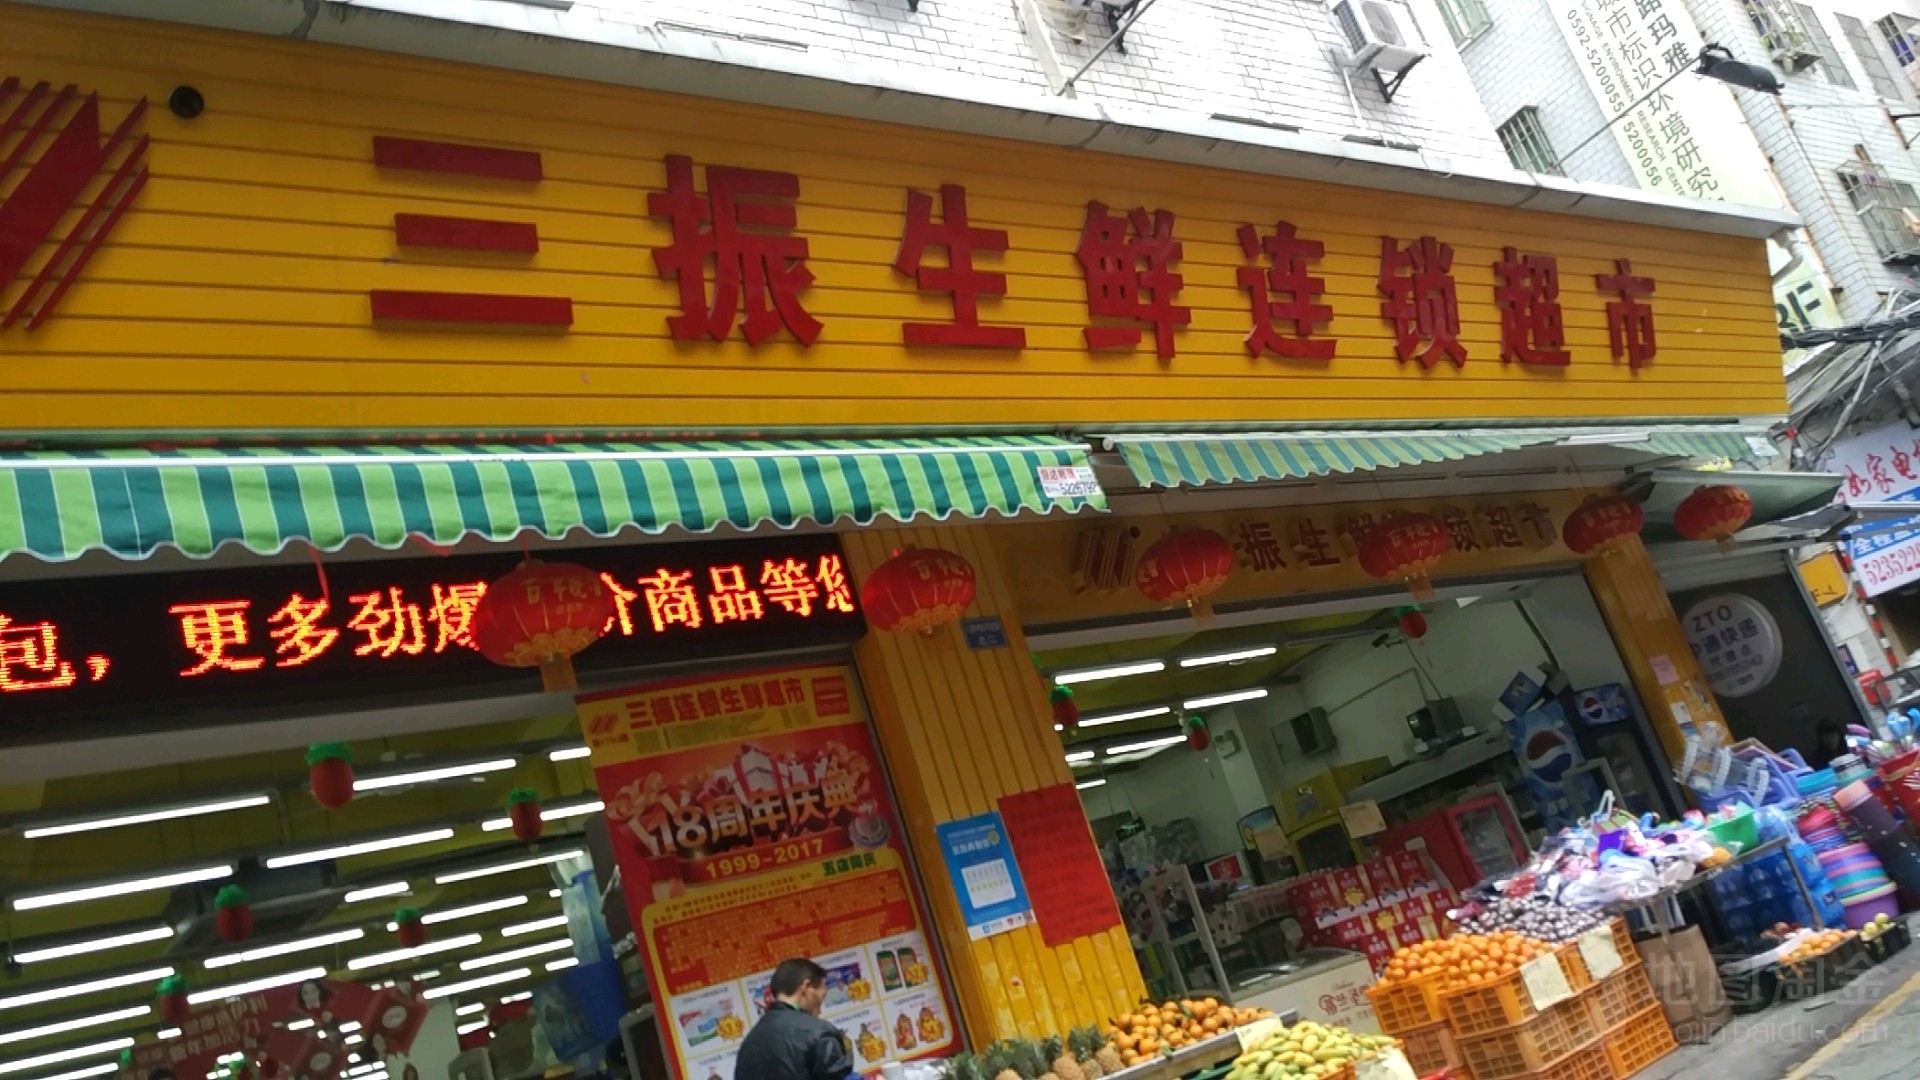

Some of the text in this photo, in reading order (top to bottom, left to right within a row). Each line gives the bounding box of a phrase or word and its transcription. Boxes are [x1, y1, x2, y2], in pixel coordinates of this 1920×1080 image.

[1623, 121, 1662, 187] 5200056
[1637, 110, 1667, 162] RESEARCH
[369, 136, 1657, 372] 三振生鲜连锁超市
[1692, 605, 1732, 632] ZTO
[706, 838, 824, 879] 1999-2017
